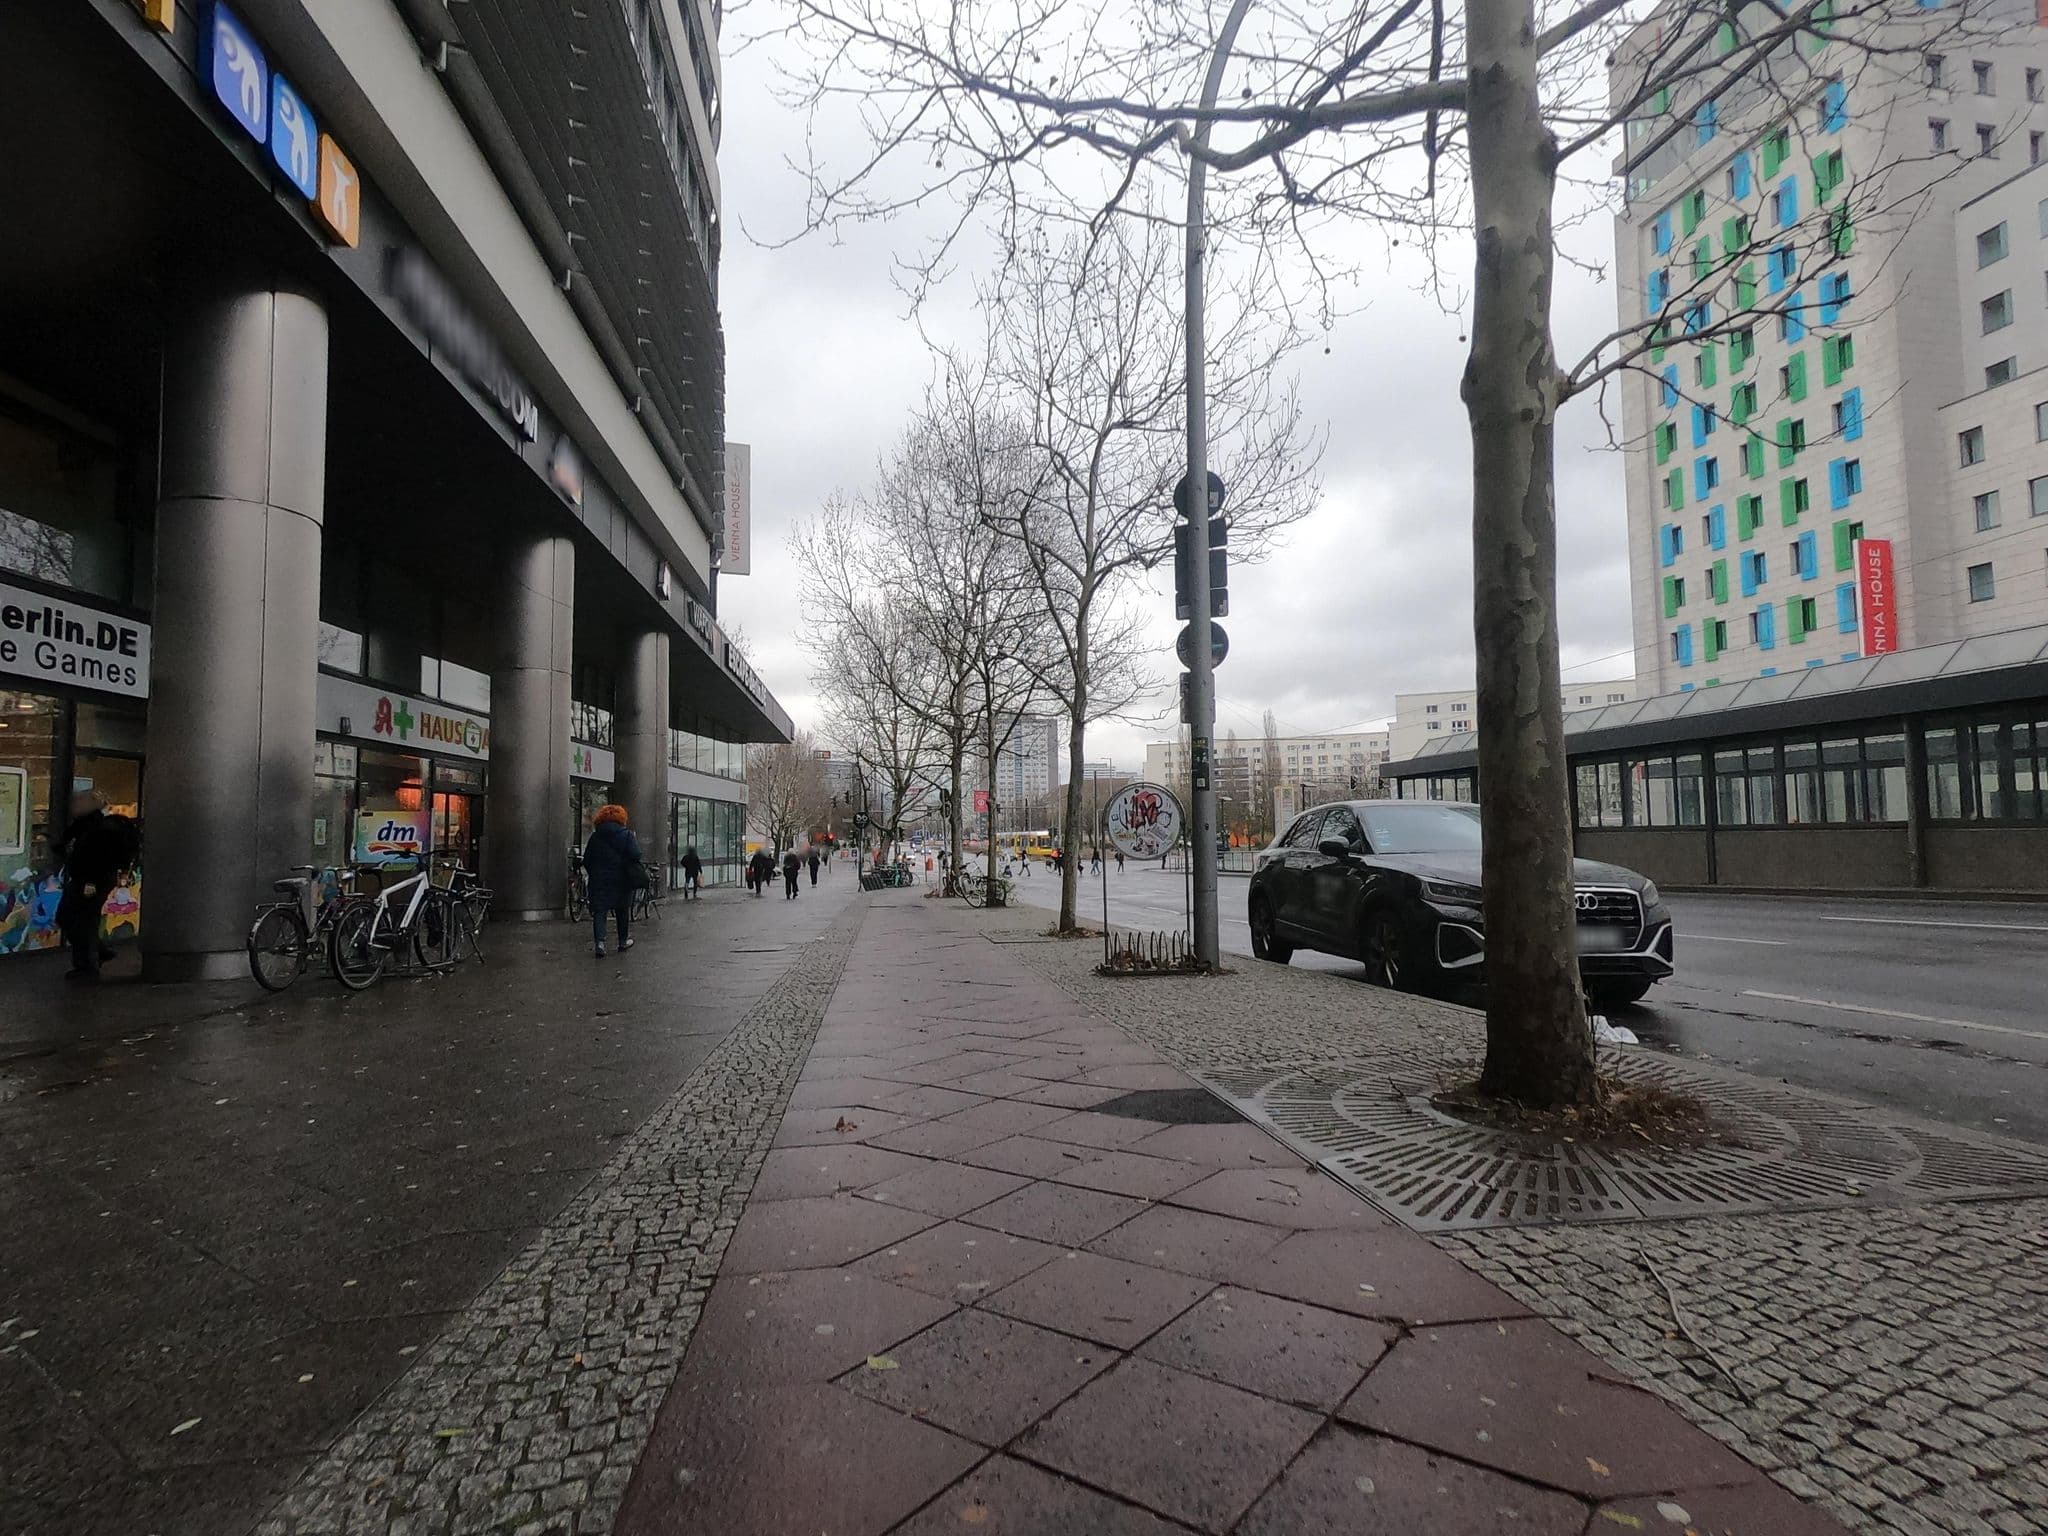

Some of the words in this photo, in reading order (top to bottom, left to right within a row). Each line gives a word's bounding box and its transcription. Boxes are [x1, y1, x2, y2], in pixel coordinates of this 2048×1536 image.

[731, 481, 741, 519] HOUSE
[731, 521, 741, 562] VIENNA
[1868, 547, 1884, 607] HOUSE
[34, 640, 137, 687] Games
[420, 711, 464, 746] HAUS
[376, 820, 416, 842] dm
